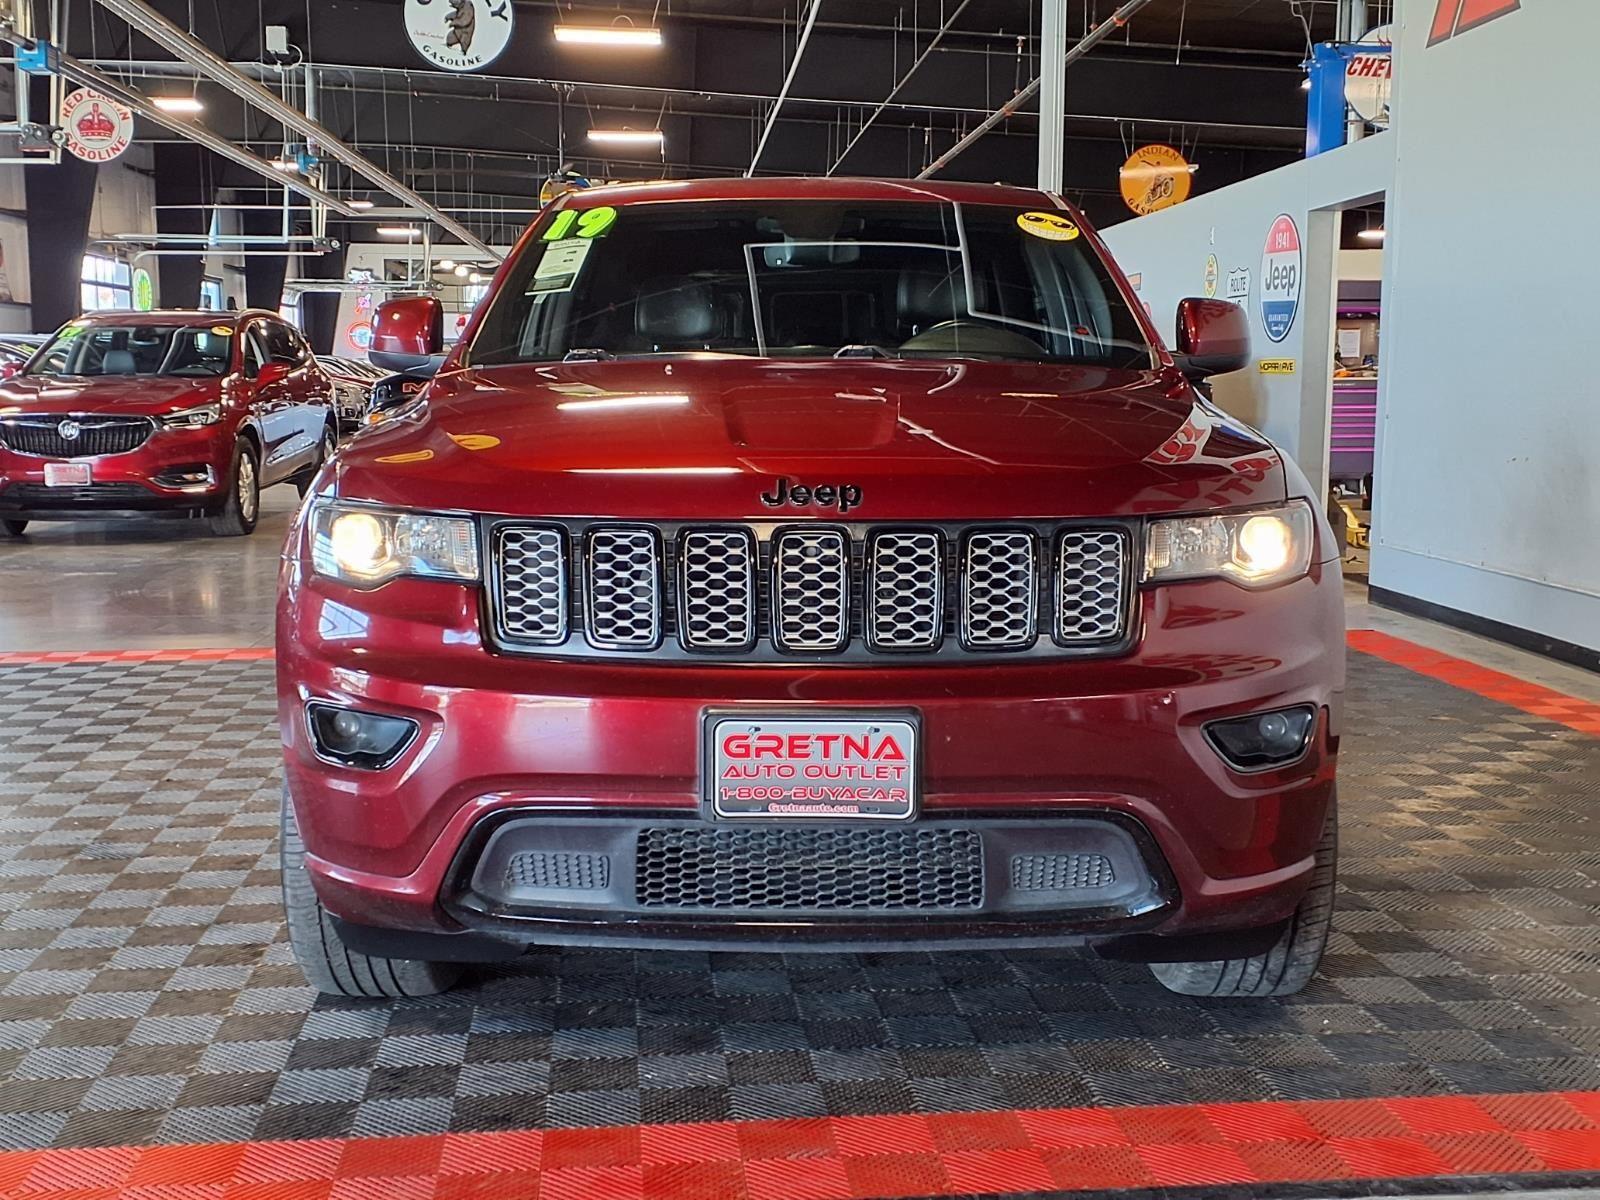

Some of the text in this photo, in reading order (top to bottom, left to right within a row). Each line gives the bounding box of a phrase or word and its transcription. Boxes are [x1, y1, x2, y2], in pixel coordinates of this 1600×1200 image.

[422, 44, 482, 67] GASOLINE
[62, 92, 84, 118] RED
[1136, 147, 1179, 161] INDIAN
[541, 206, 617, 241] 19
[1275, 231, 1290, 249] 1941
[1230, 276, 1247, 292] ROUTE
[1265, 258, 1296, 297] Jeep
[760, 478, 863, 514] Jeep
[722, 734, 906, 761] GRETNA
[722, 764, 908, 781] AUTO OUTLET
[720, 785, 907, 802] 1-800-BUYACAR
[768, 802, 859, 814] Gretnaauto.com
